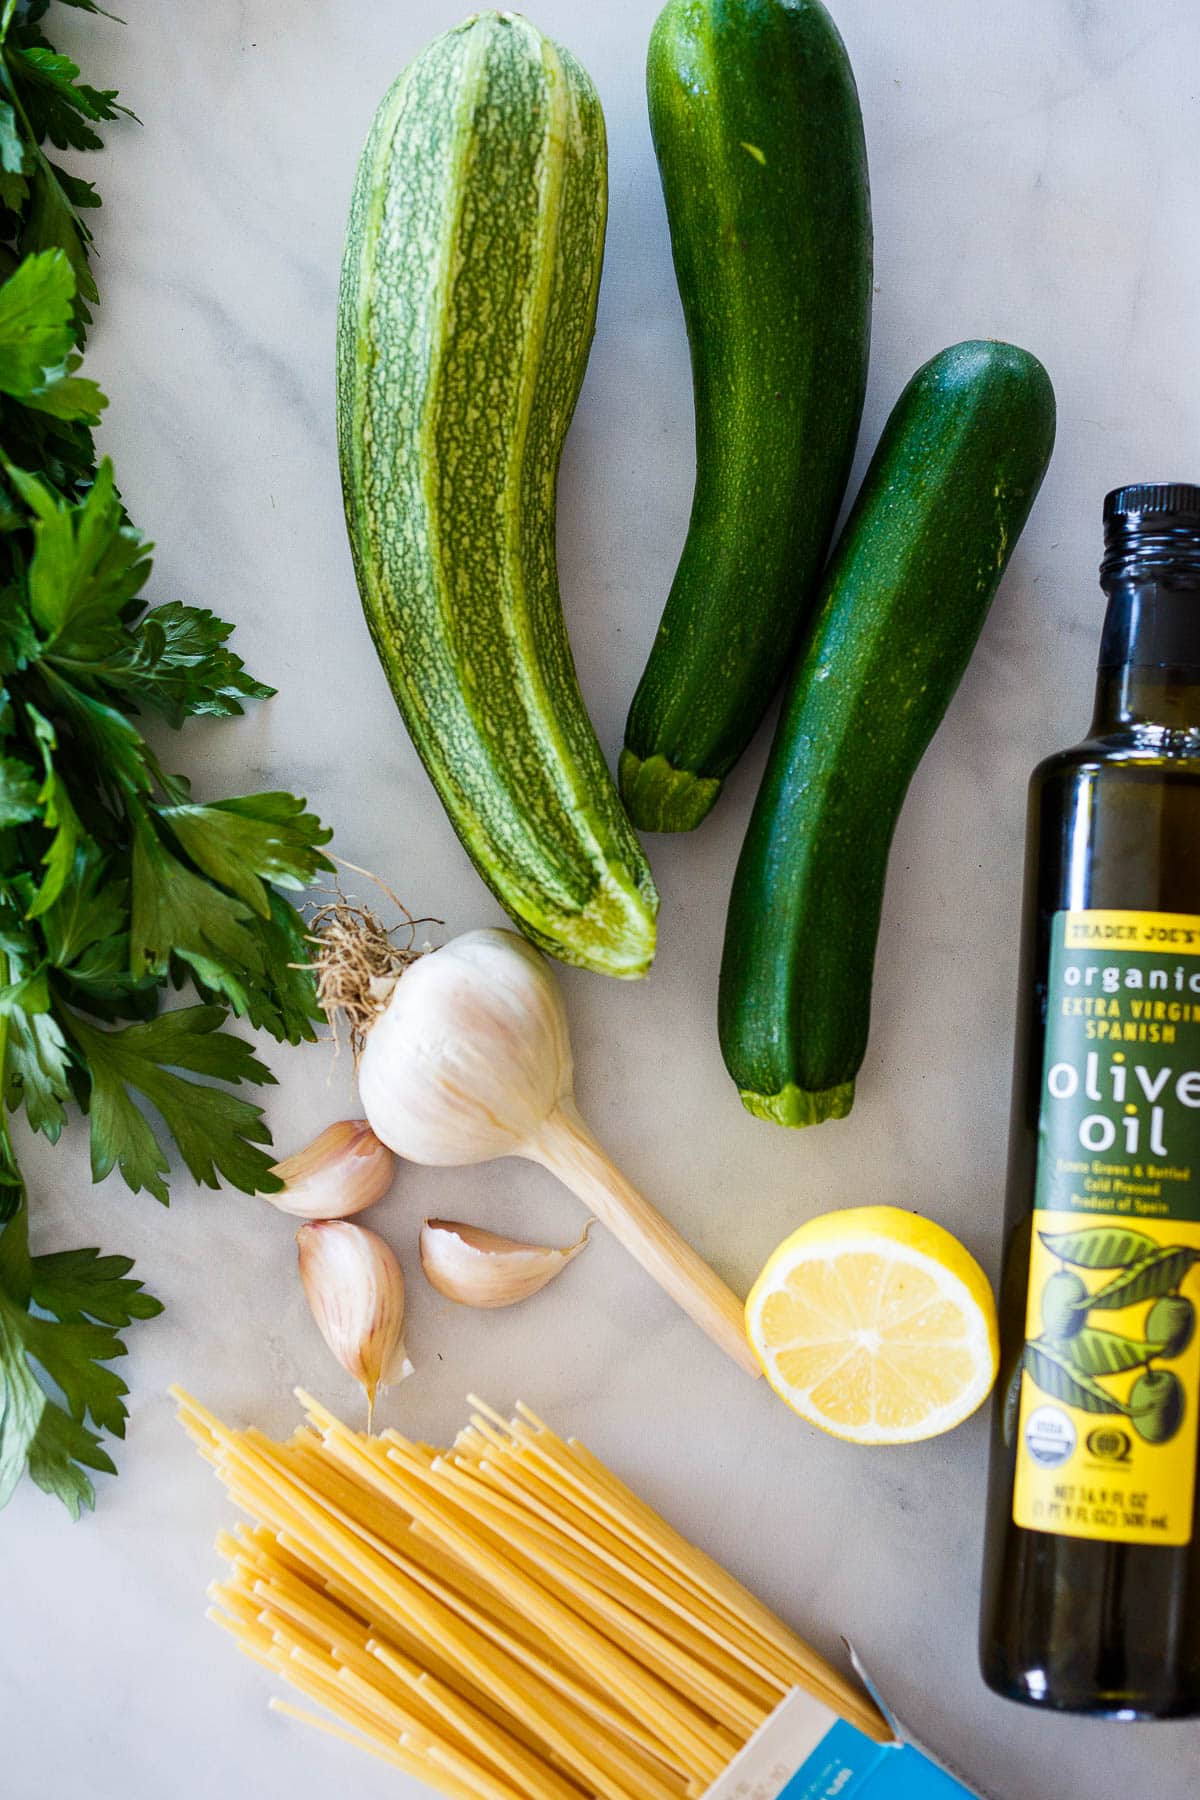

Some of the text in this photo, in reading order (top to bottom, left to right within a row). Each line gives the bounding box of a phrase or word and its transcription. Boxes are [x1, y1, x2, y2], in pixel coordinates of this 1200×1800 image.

[1071, 924, 1137, 940] TRADER
[1063, 966, 1200, 993] organic
[1061, 997, 1200, 1023] EXTRA VIRGIN
[1085, 1019, 1176, 1044] SPANISH
[1047, 1051, 1200, 1108] olive
[1078, 1103, 1168, 1156] oil
[1084, 1177, 1111, 1192] Cold
[1070, 1193, 1169, 1215] Product of Spain
